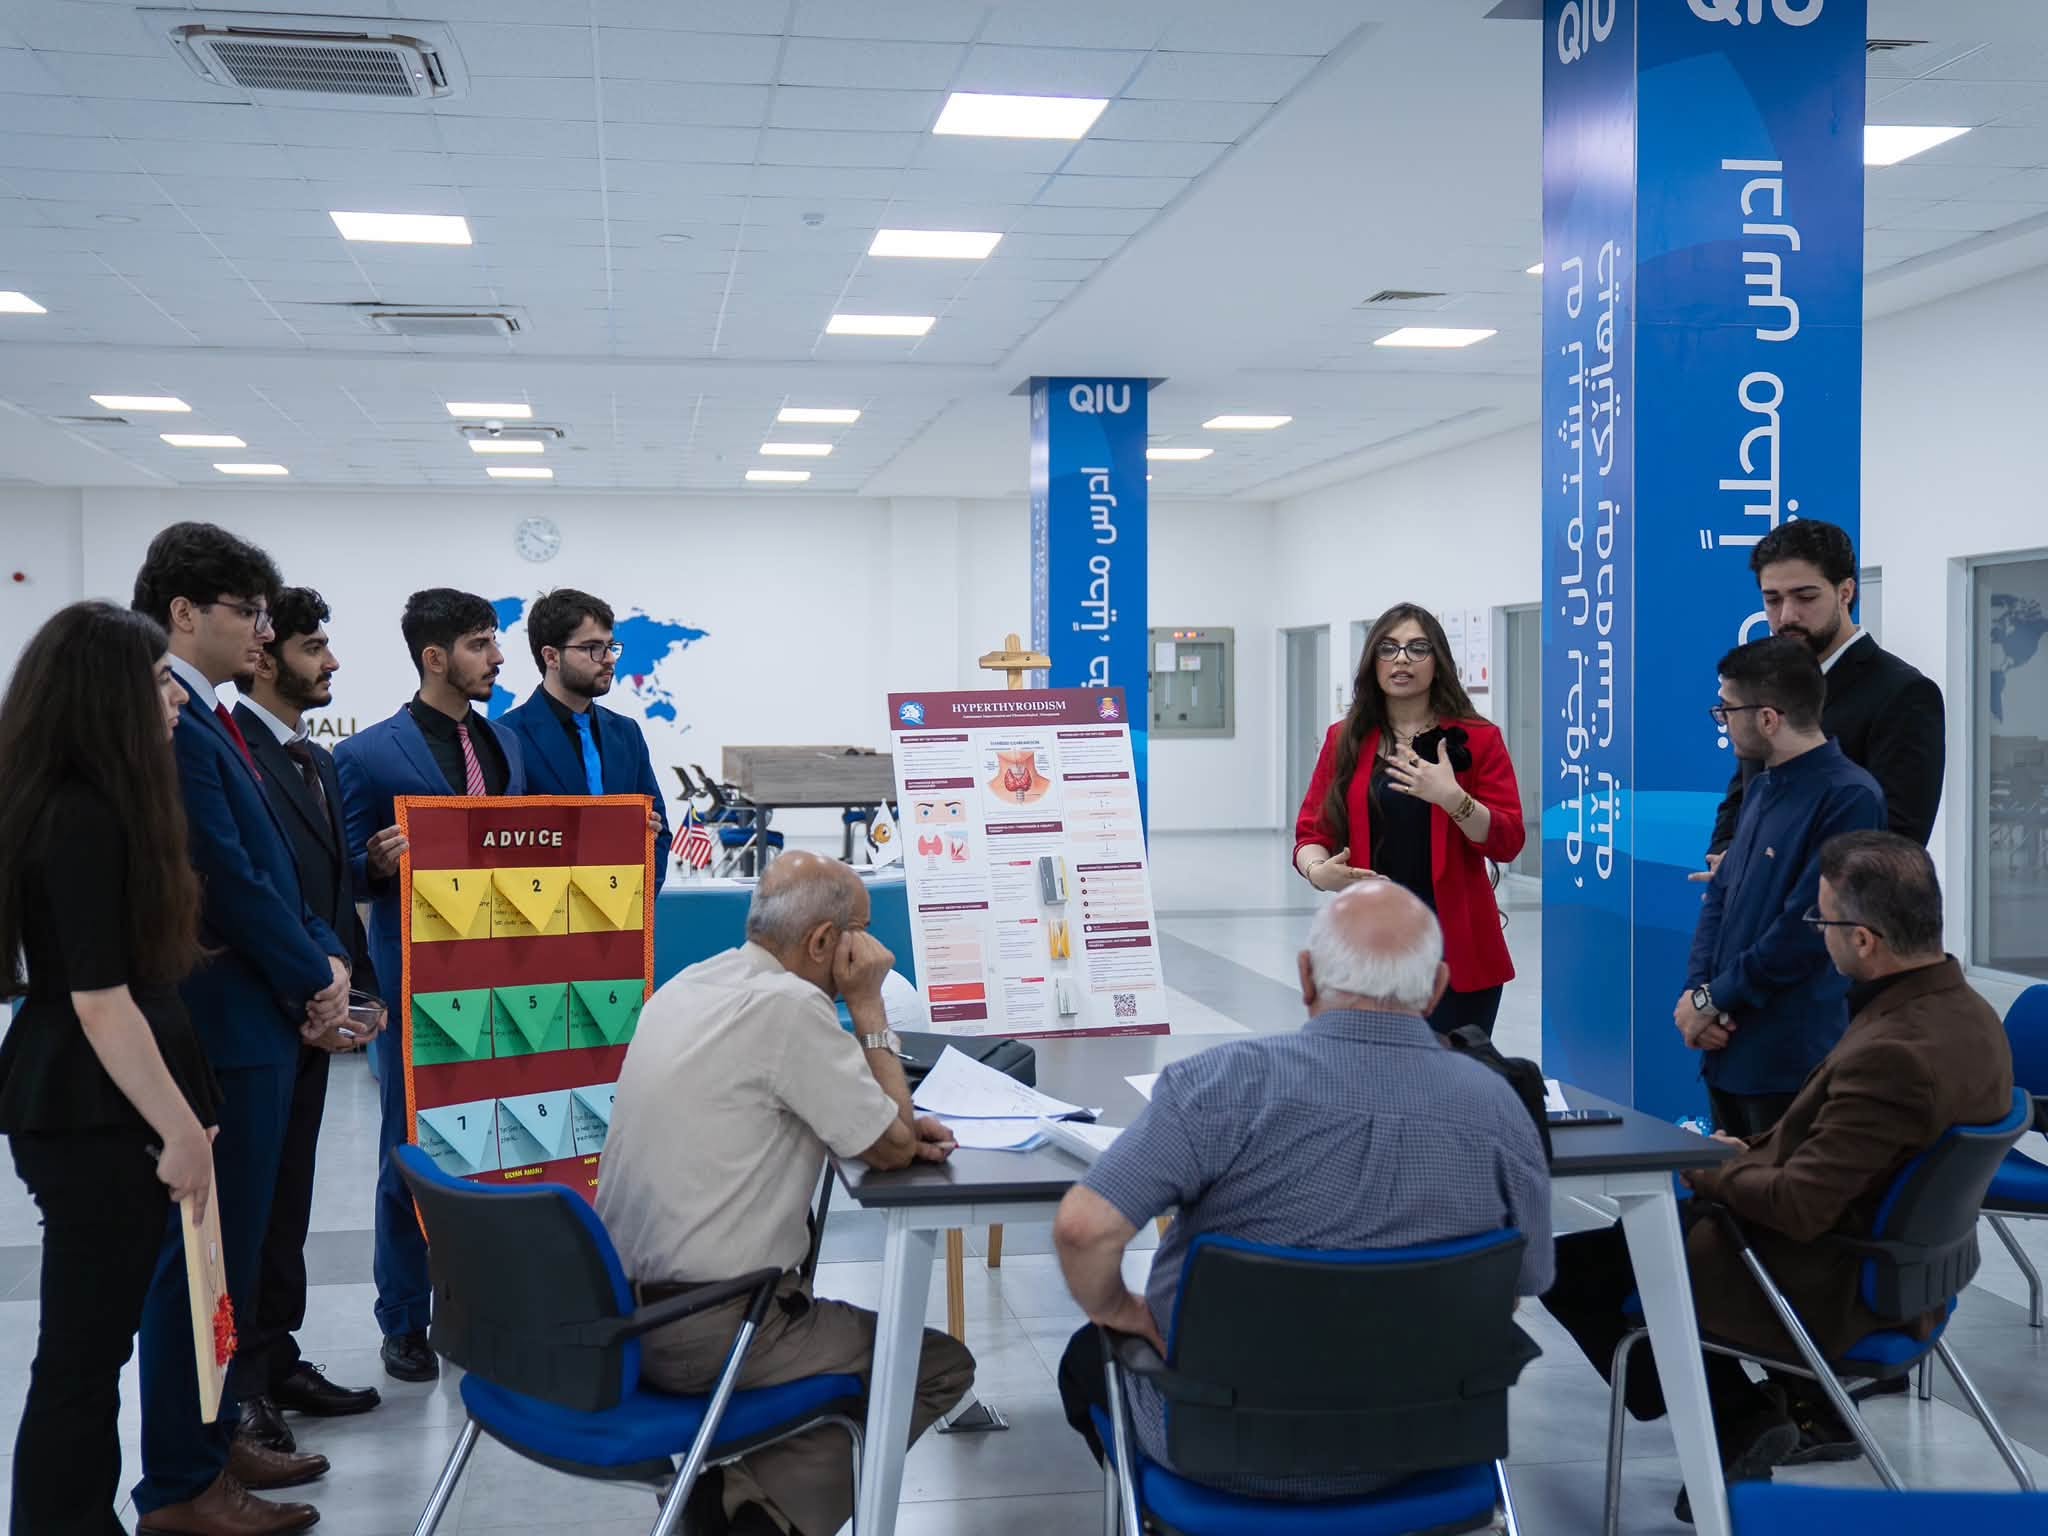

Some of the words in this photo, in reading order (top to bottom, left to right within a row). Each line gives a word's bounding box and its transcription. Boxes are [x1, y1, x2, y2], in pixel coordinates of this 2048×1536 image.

[1721, 159, 1801, 342] ادرس
[1068, 384, 1131, 414] QIU
[1080, 467, 1117, 545] ادرس
[951, 700, 1067, 713] HYPERTHYROIDISM
[482, 829, 563, 847] ADVICE
[451, 878, 460, 892] 1
[532, 879, 542, 892] 2
[609, 876, 618, 889] 3
[529, 995, 537, 1009] 5
[609, 991, 617, 1004] 6
[452, 998, 461, 1012] 4
[537, 1103, 548, 1117] 8
[457, 1115, 467, 1131] 7
